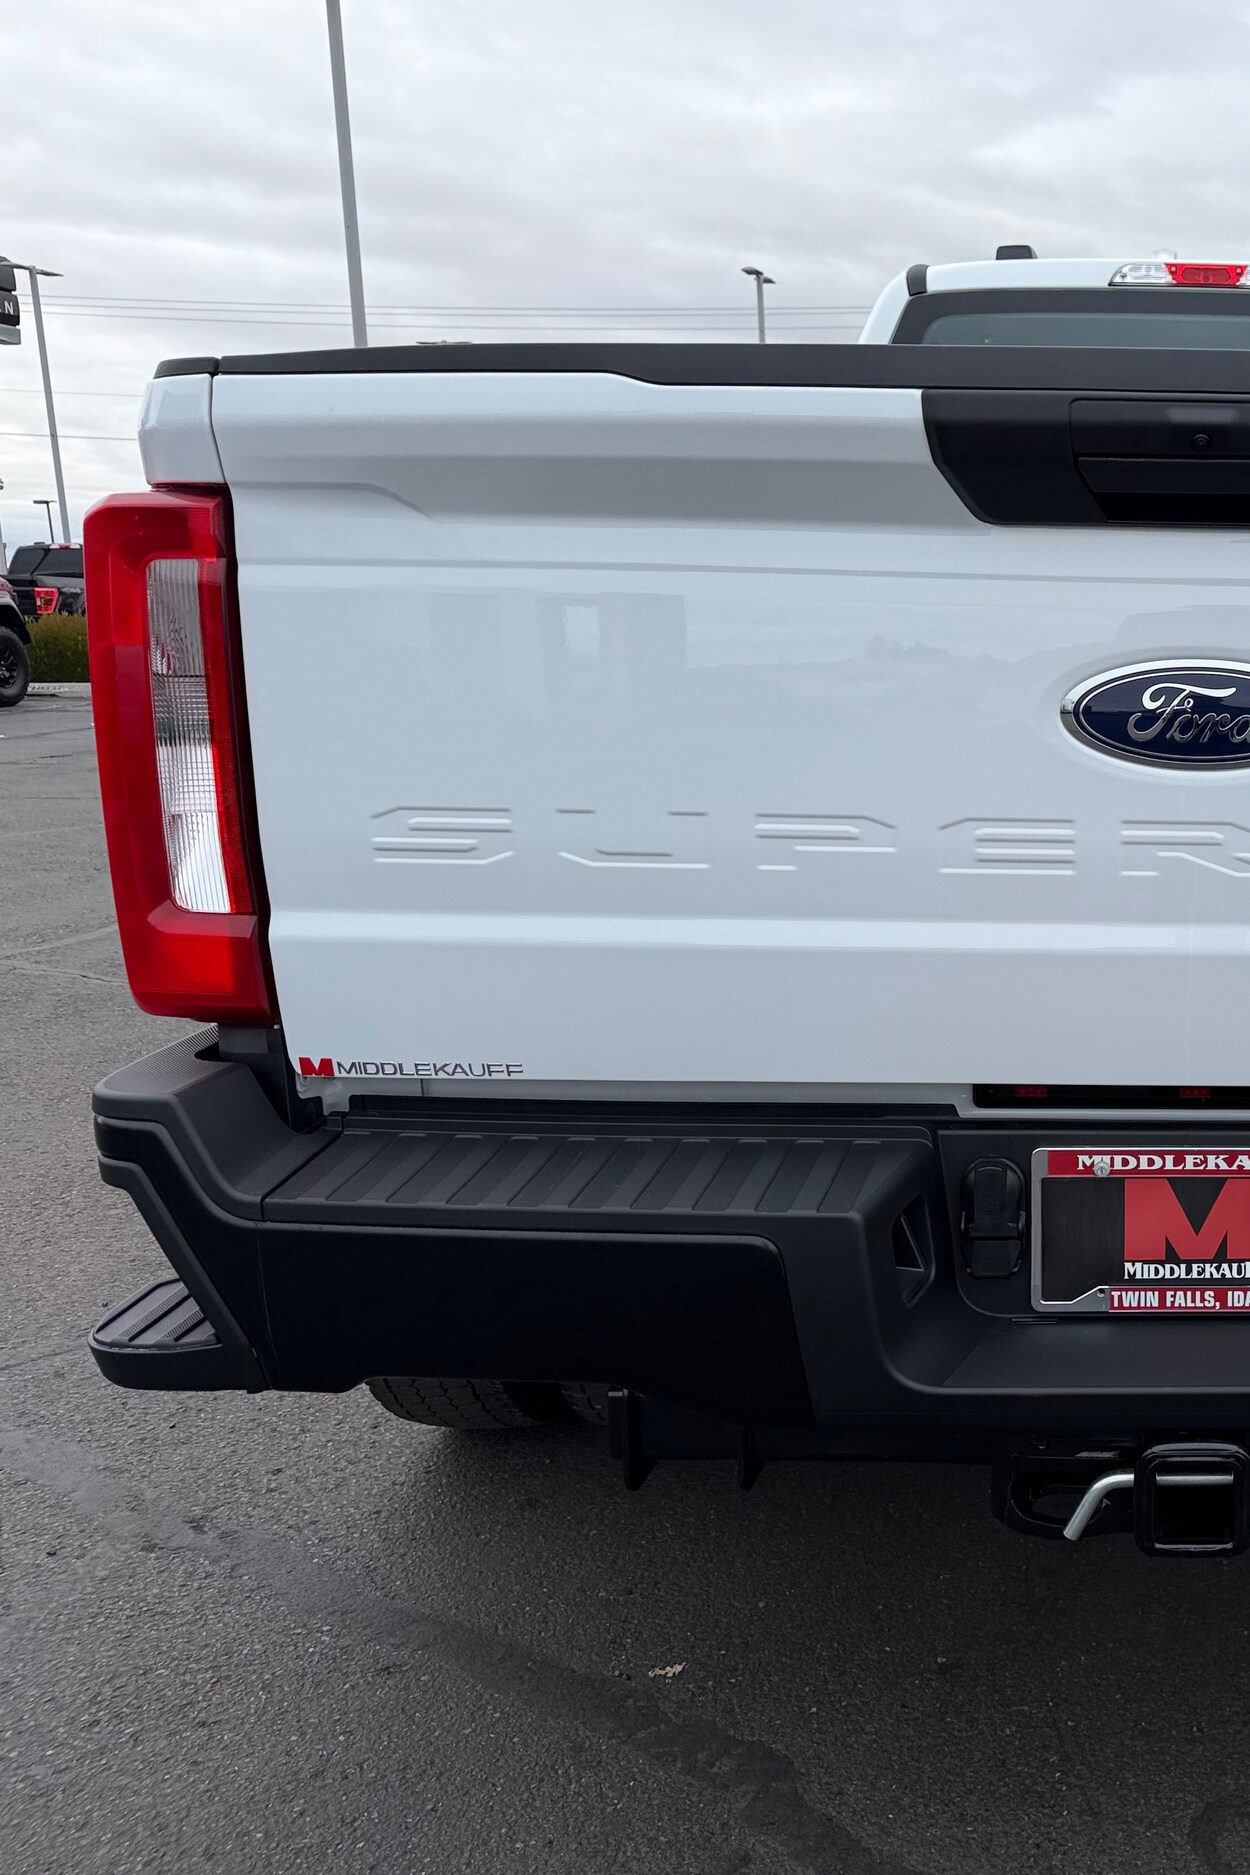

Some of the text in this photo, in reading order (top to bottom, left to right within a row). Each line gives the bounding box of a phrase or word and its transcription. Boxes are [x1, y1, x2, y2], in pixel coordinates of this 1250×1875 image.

[336, 1060, 524, 1078] MIDDLEKAUFF
[1111, 1291, 1159, 1308] TWIN
[1165, 1291, 1221, 1310] FALLS,
